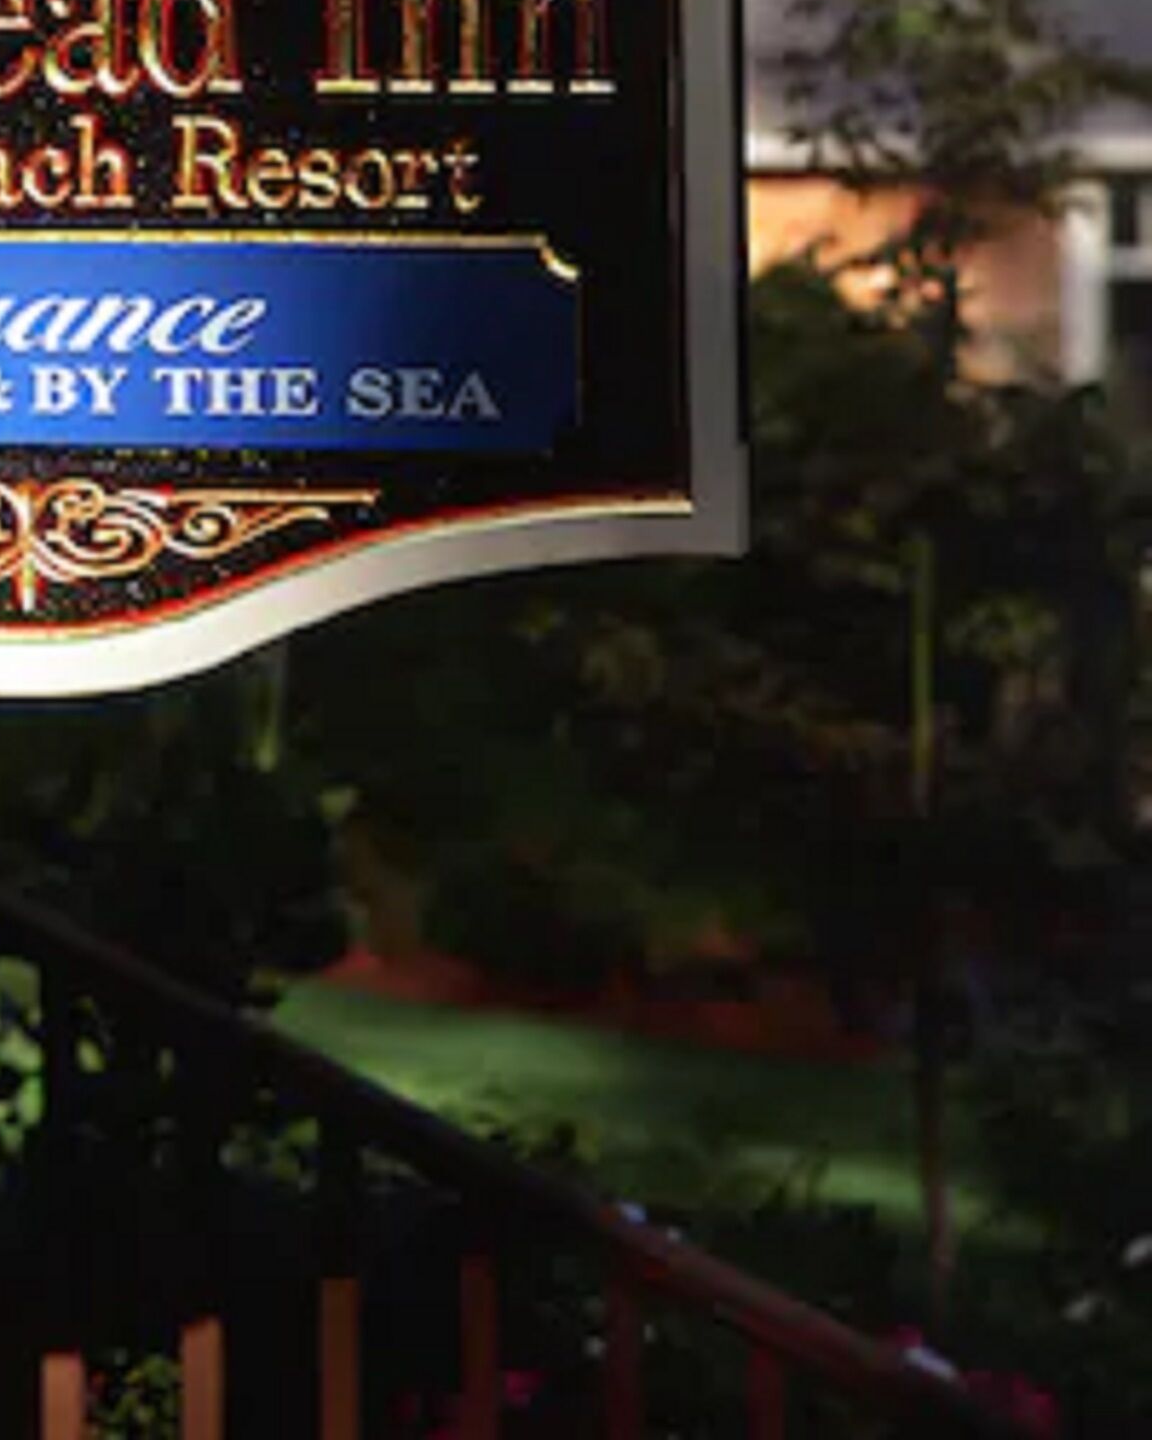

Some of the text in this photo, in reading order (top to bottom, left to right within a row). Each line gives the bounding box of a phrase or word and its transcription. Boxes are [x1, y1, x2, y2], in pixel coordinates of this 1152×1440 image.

[172, 114, 481, 212] Resort
[32, 363, 128, 416] BY
[154, 366, 319, 419] THE
[345, 368, 502, 422] SEA
